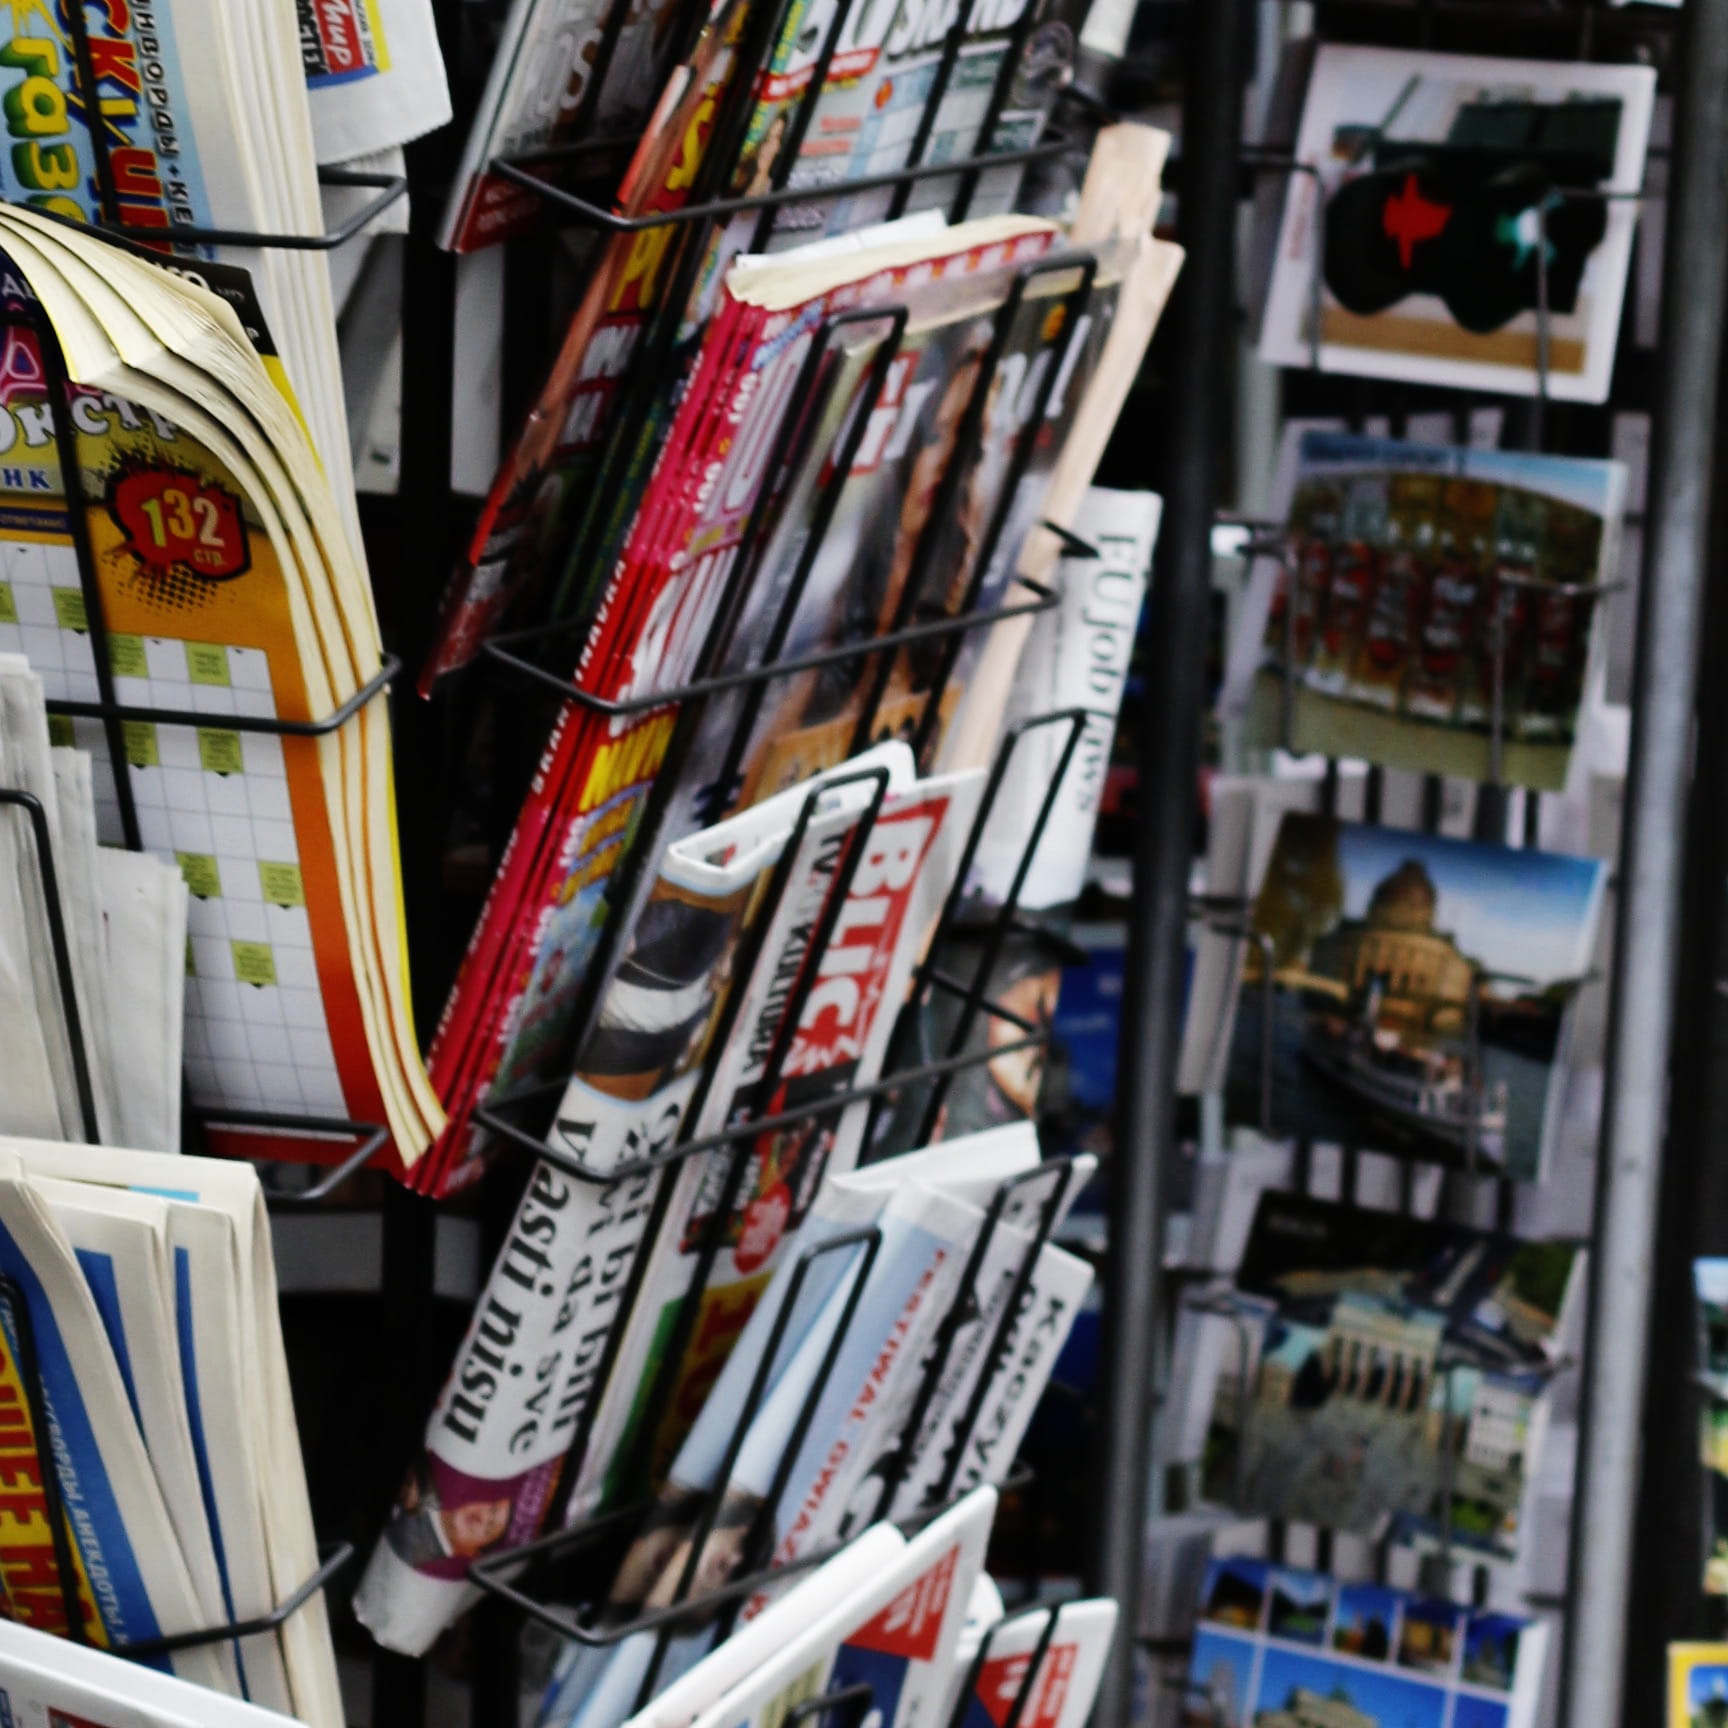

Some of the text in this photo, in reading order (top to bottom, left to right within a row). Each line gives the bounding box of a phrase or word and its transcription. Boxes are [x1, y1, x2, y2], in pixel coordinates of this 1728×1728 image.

[138, 487, 225, 550] 132
[440, 1297, 526, 1447] nisu
[847, 1248, 951, 1427] FESTIWAL
